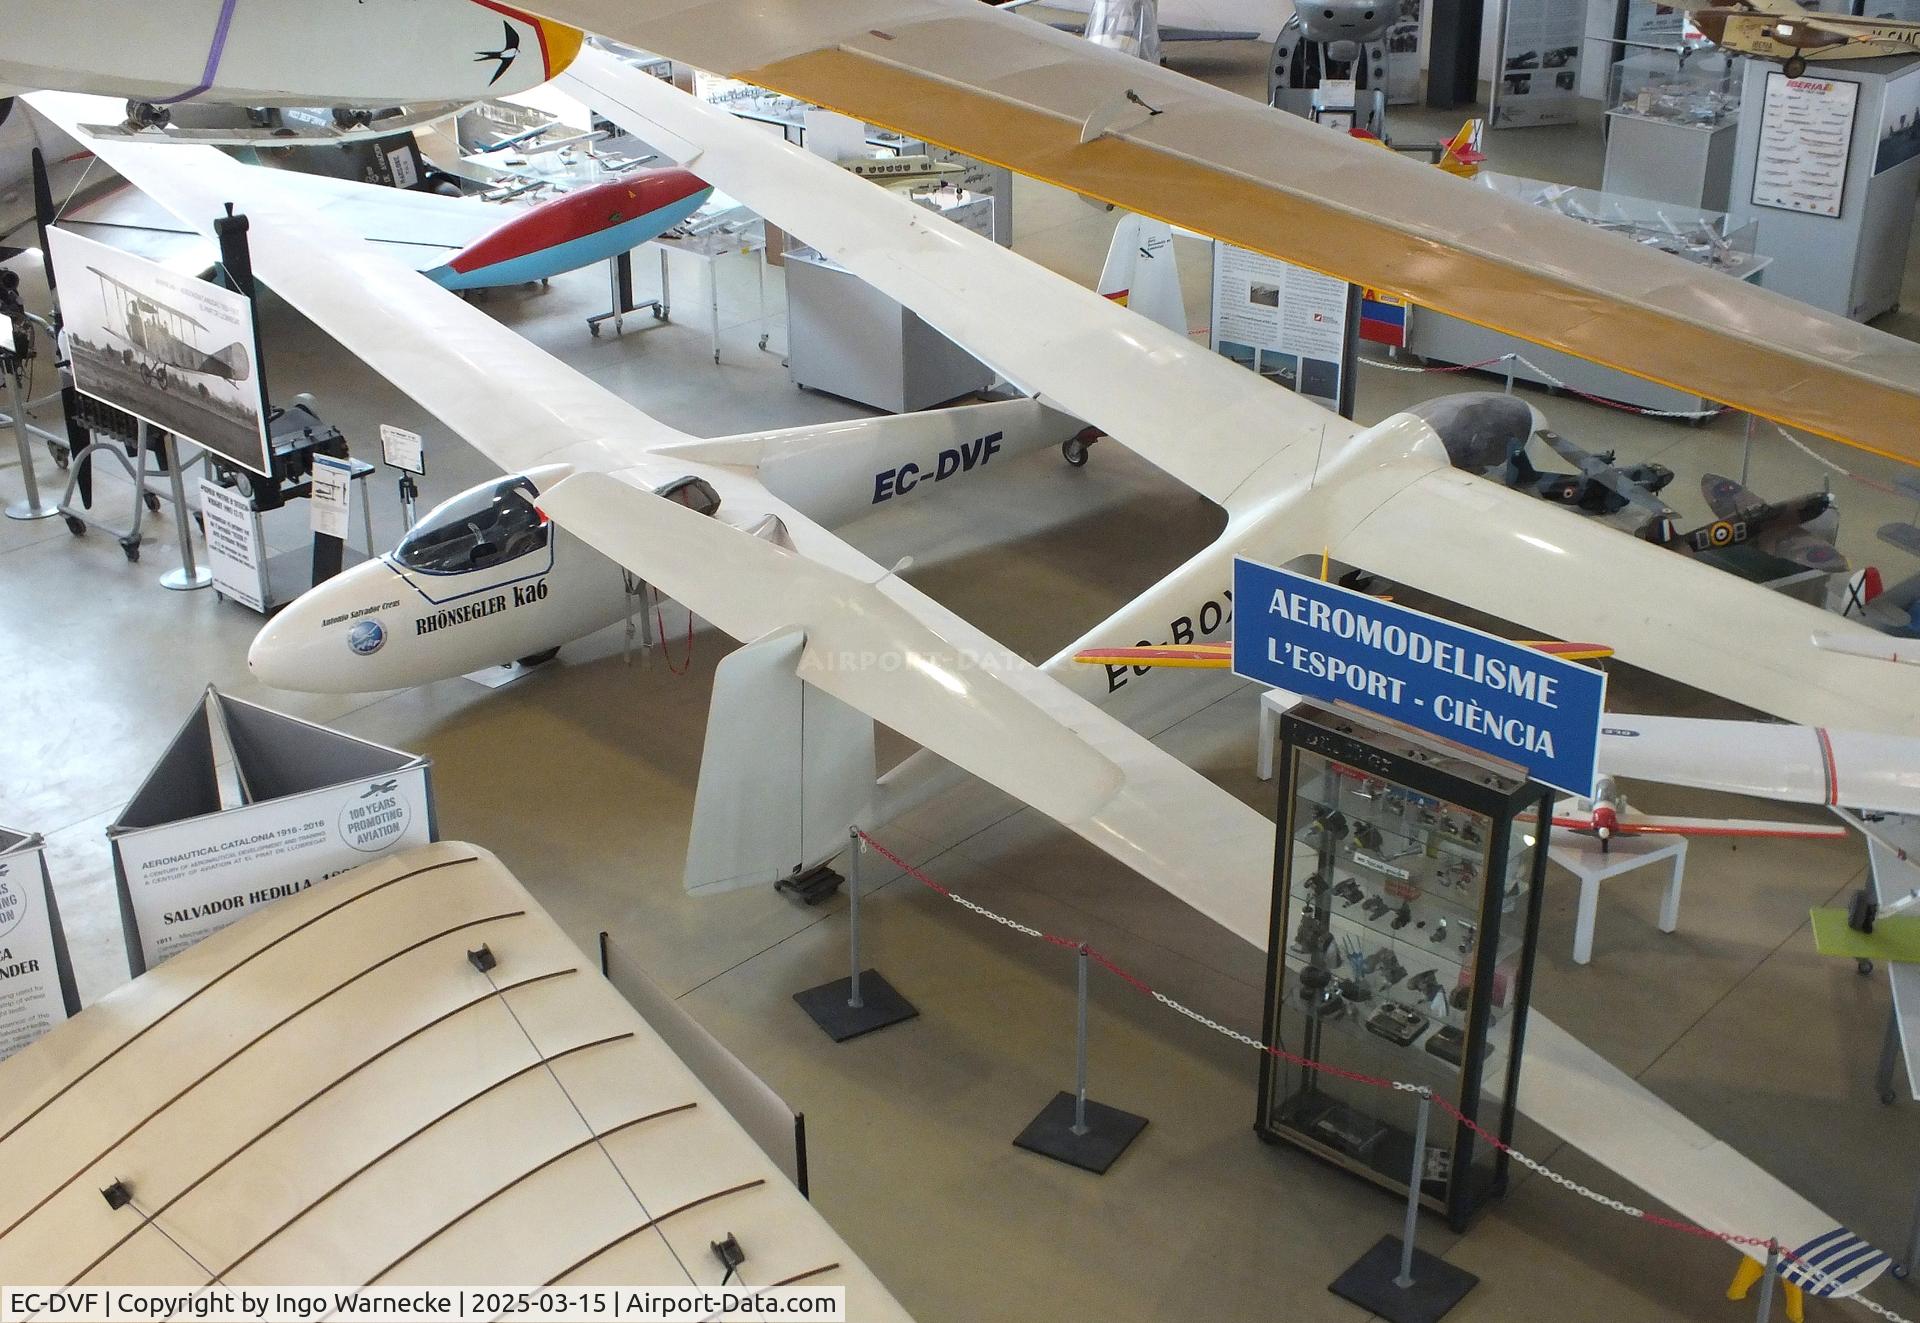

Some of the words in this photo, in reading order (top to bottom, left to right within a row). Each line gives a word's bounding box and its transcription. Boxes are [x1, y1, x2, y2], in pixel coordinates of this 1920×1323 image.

[1787, 80, 1823, 90] IBERIA
[872, 431, 1003, 504] EC-DVF
[350, 605, 380, 618] Salvador
[416, 595, 506, 636] RHÖNSEGLER
[1268, 588, 1559, 709] AEROMODELISME
[1267, 637, 1407, 704] L'ESPORT
[1434, 695, 1555, 759] CIÈNCIA
[348, 808, 403, 834] PROMOTING
[350, 807, 365, 820] 100
[366, 797, 396, 814] YEARS
[142, 845, 219, 870] AERONAUTICAL
[220, 832, 275, 852] CATALONIA
[357, 822, 400, 844] AVIATION
[164, 896, 245, 926] SALVADOR
[250, 879, 312, 905] HEDILLA
